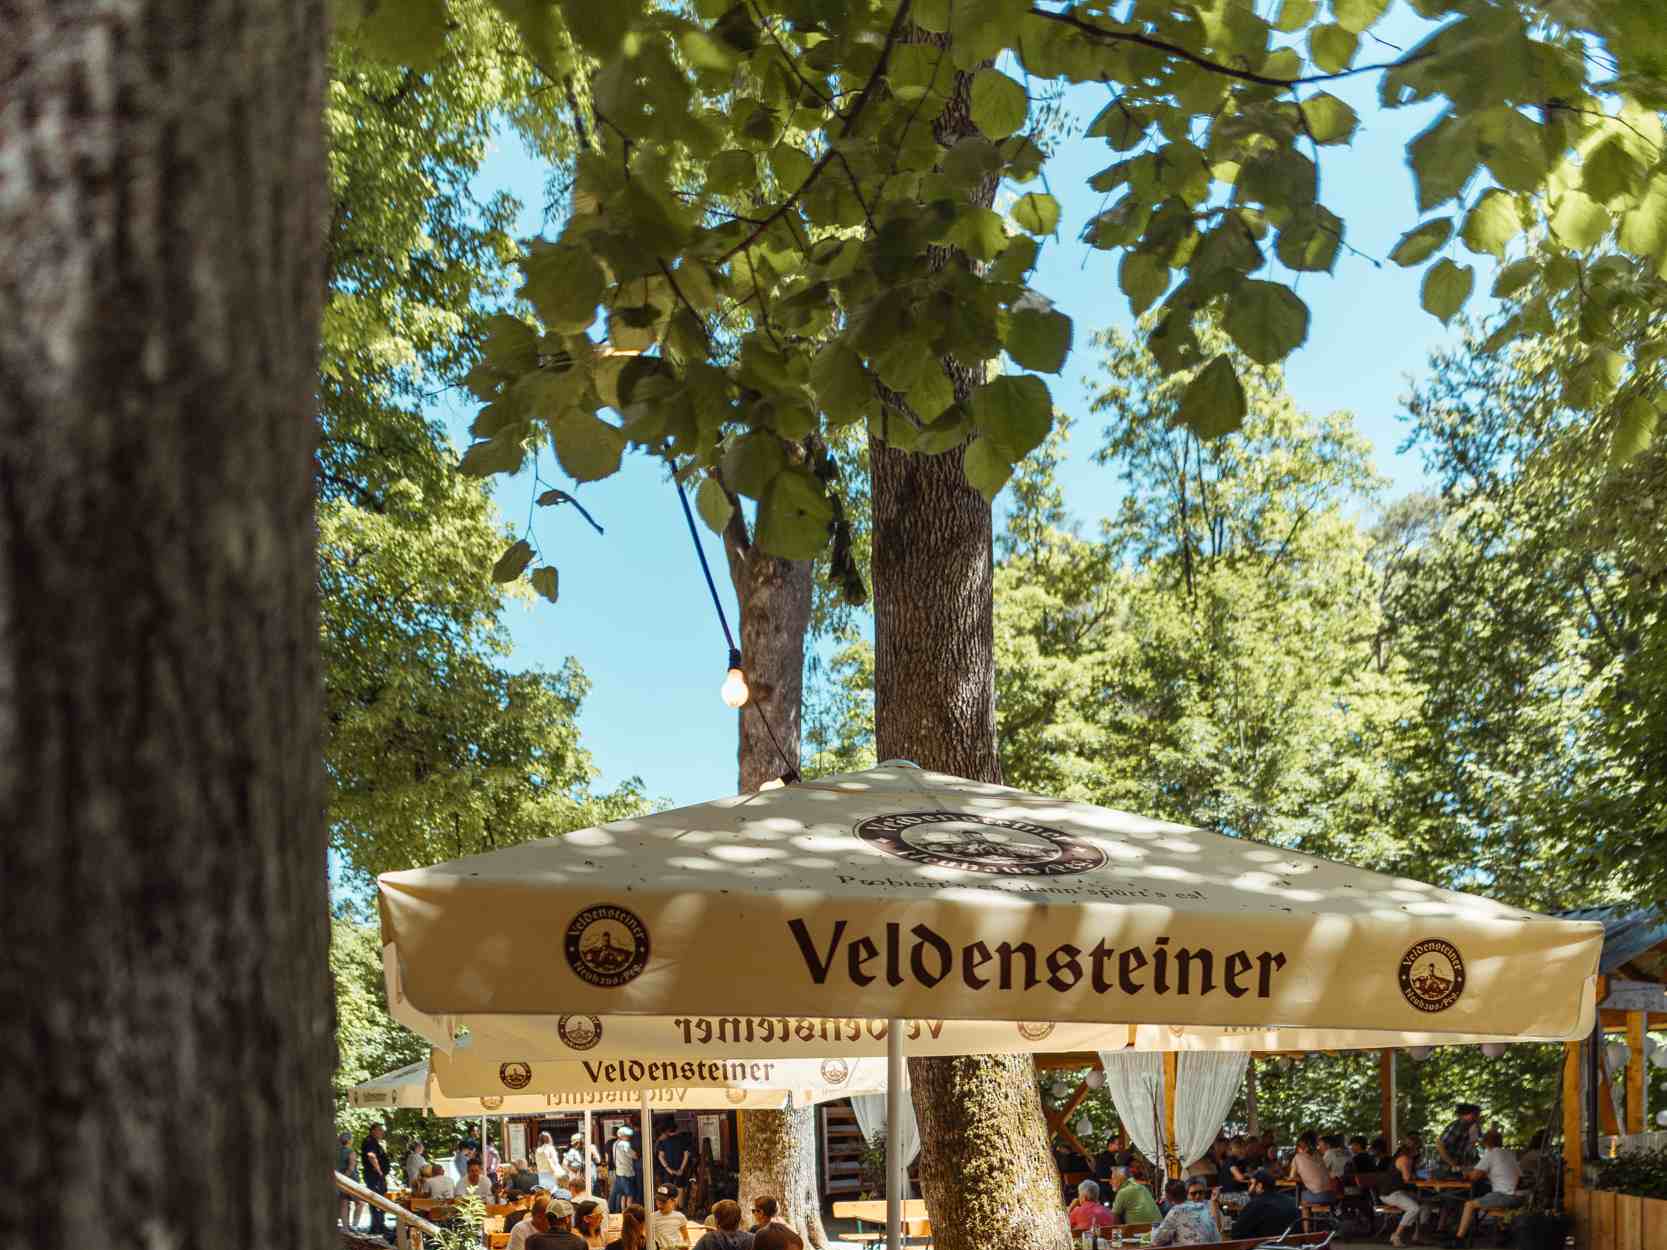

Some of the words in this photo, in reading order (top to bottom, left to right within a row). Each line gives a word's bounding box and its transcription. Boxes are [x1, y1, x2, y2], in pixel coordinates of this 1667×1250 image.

[864, 813, 1073, 842] Veldensteiner
[567, 907, 645, 938] Veldensteiner
[787, 917, 1288, 998] Veldensteiner
[1402, 942, 1462, 970] Veldensteiner
[582, 1059, 775, 1083] Veldensteiner
